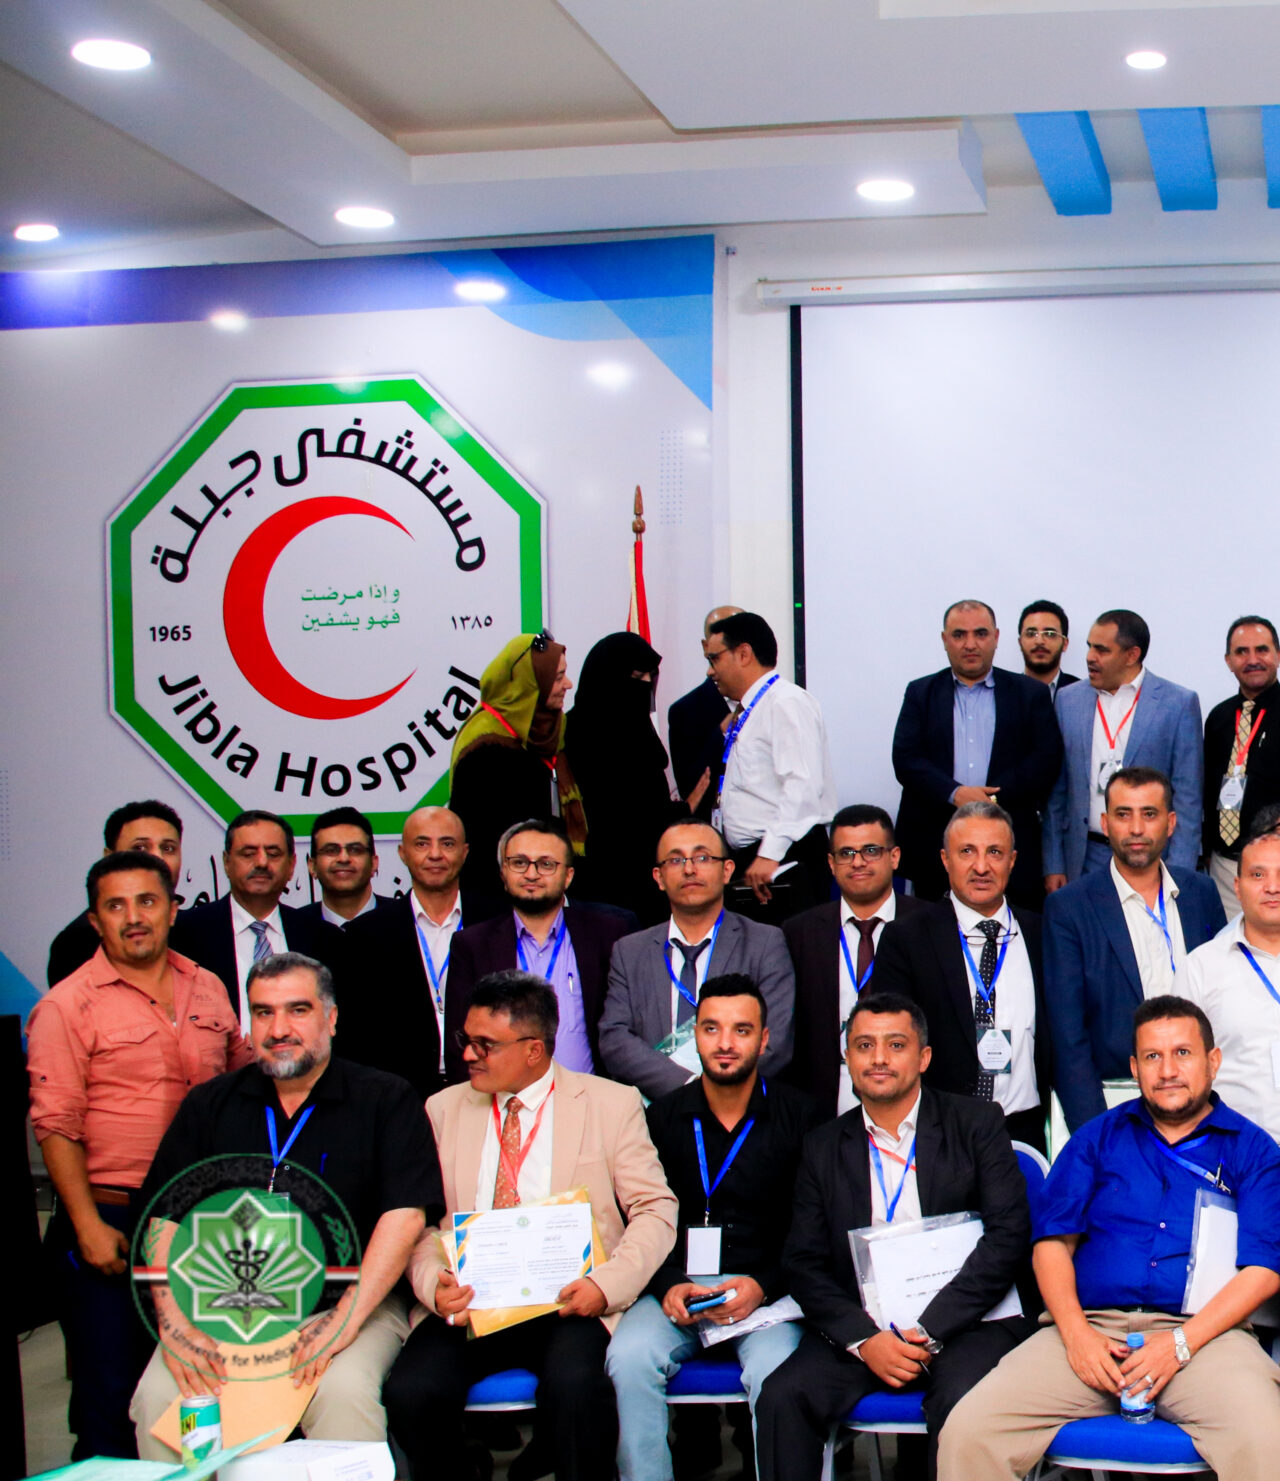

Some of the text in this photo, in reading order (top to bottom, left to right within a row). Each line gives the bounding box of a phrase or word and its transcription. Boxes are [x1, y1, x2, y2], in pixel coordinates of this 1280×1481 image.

[151, 418, 486, 583] مستشفى جبلة
[301, 587, 363, 606] مرضت
[302, 609, 400, 632] فهو يشفين
[451, 614, 493, 631] ١٣٨٥
[149, 625, 192, 642] 1965
[158, 665, 481, 797] Jibla Hospital
